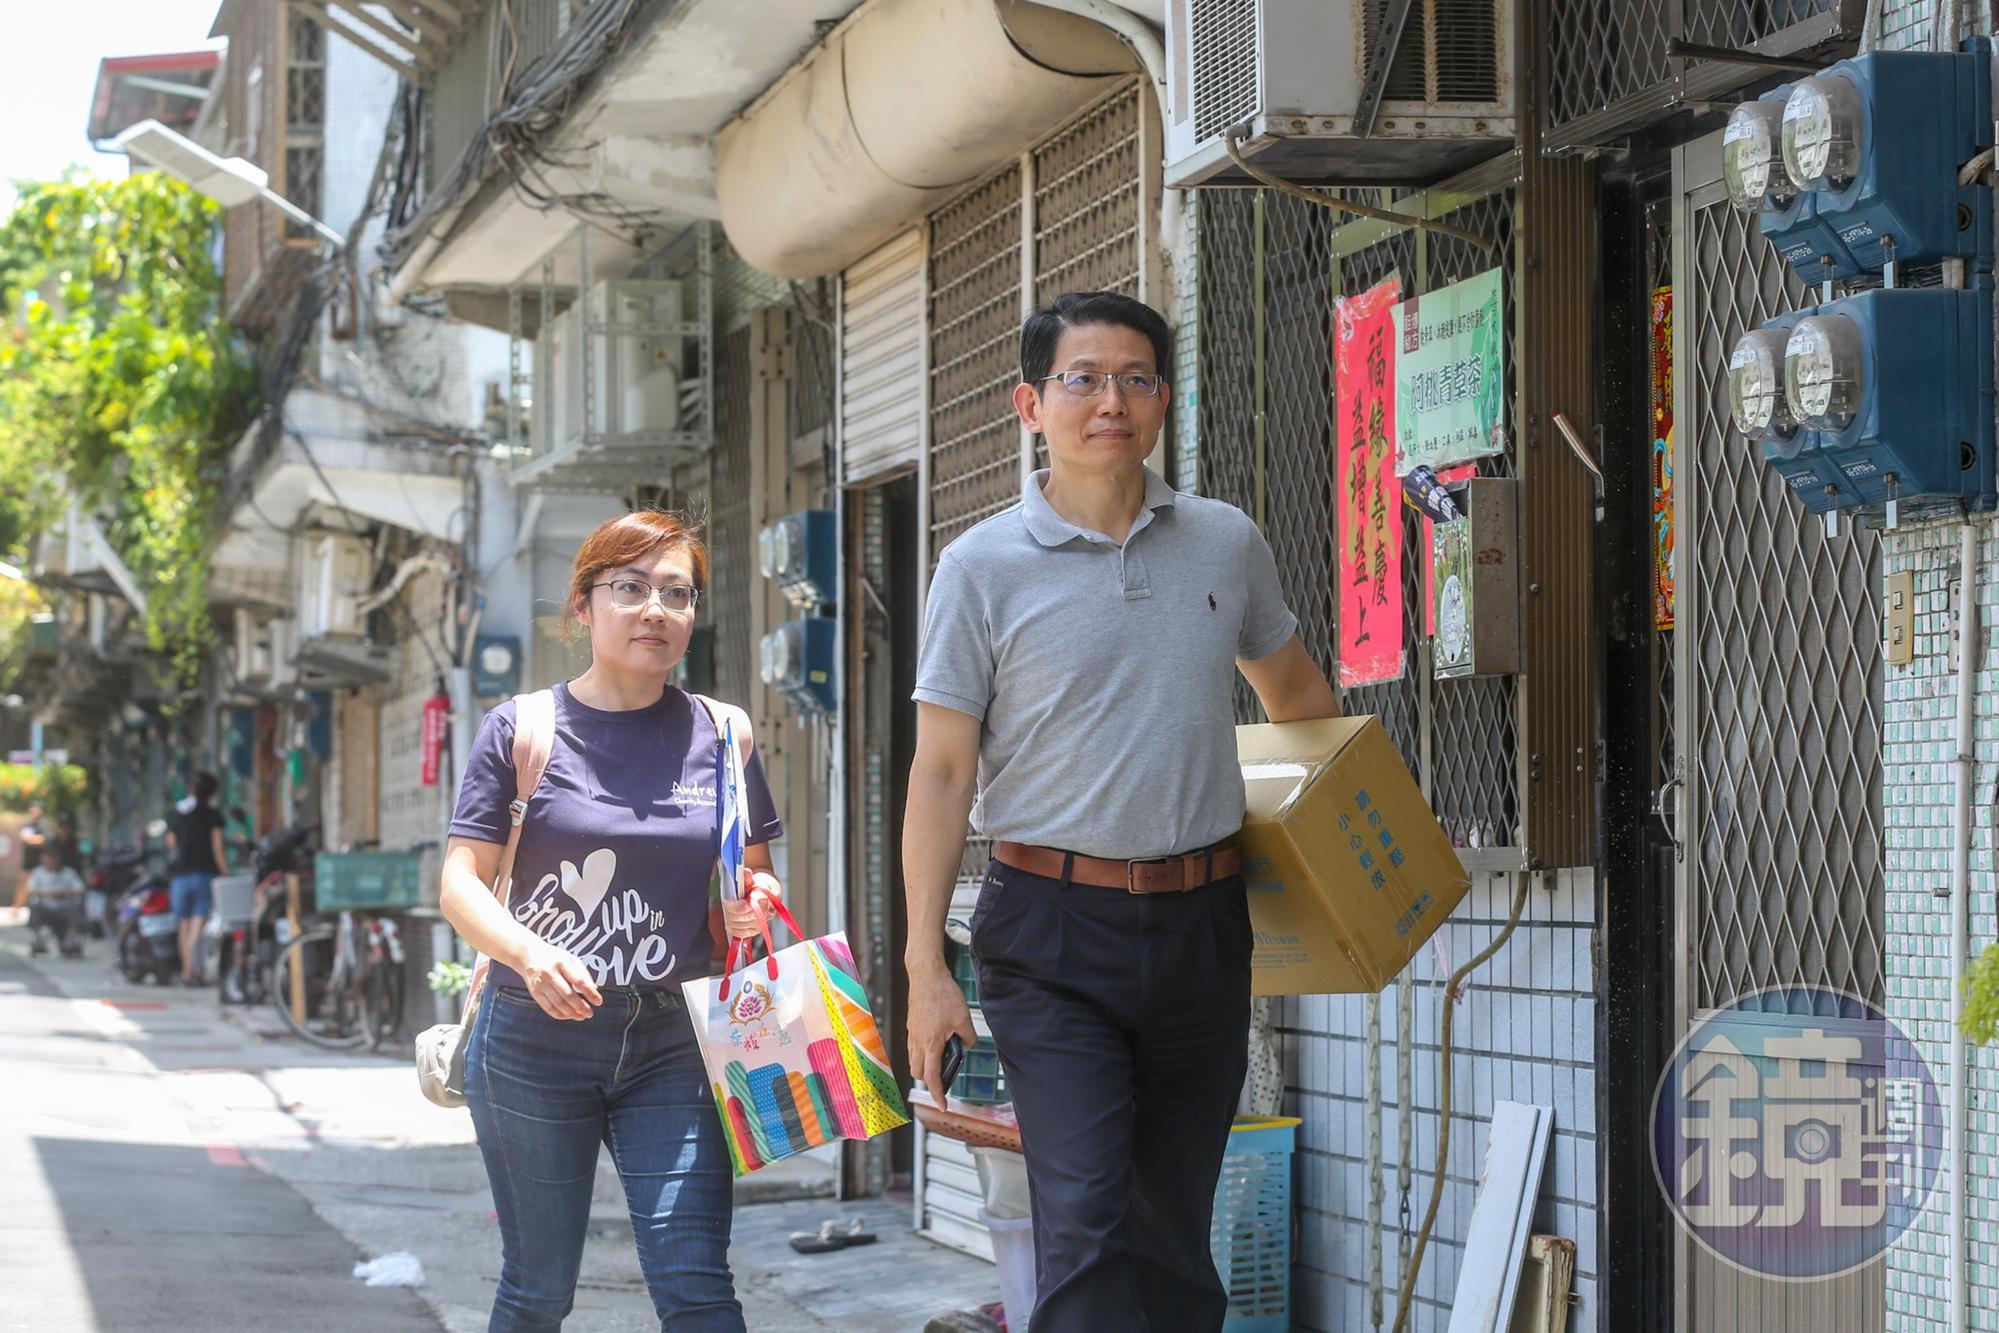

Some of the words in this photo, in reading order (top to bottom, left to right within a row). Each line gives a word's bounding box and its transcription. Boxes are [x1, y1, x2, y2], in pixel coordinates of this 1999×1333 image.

[1338, 813, 1387, 891] 小心輕放
[602, 889, 649, 944] up
[649, 909, 665, 932] in
[580, 934, 676, 986] ove
